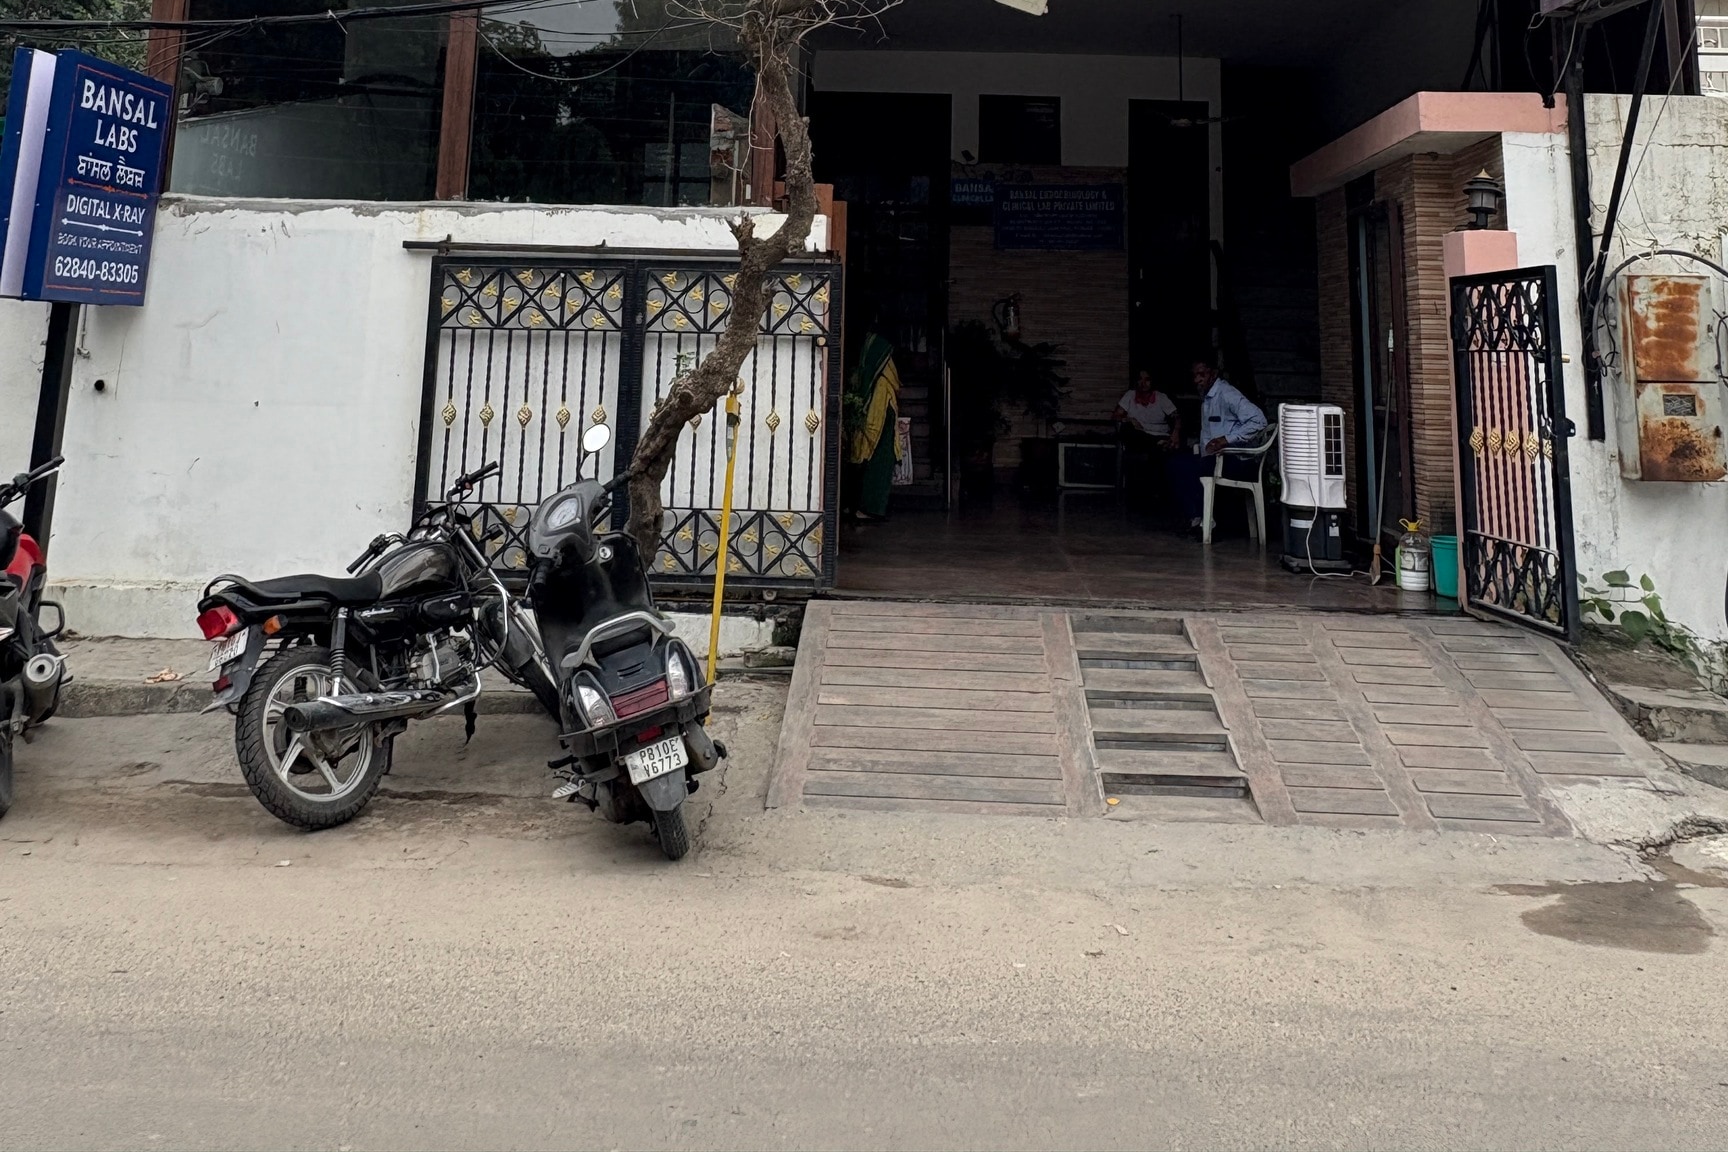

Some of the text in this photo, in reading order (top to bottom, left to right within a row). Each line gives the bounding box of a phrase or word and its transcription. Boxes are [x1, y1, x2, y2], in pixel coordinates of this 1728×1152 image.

[80, 79, 158, 130] BANSAL
[94, 119, 138, 153] LABS
[66, 194, 146, 225] DIGITAL X-RAY
[54, 255, 139, 284] 62840-83305
